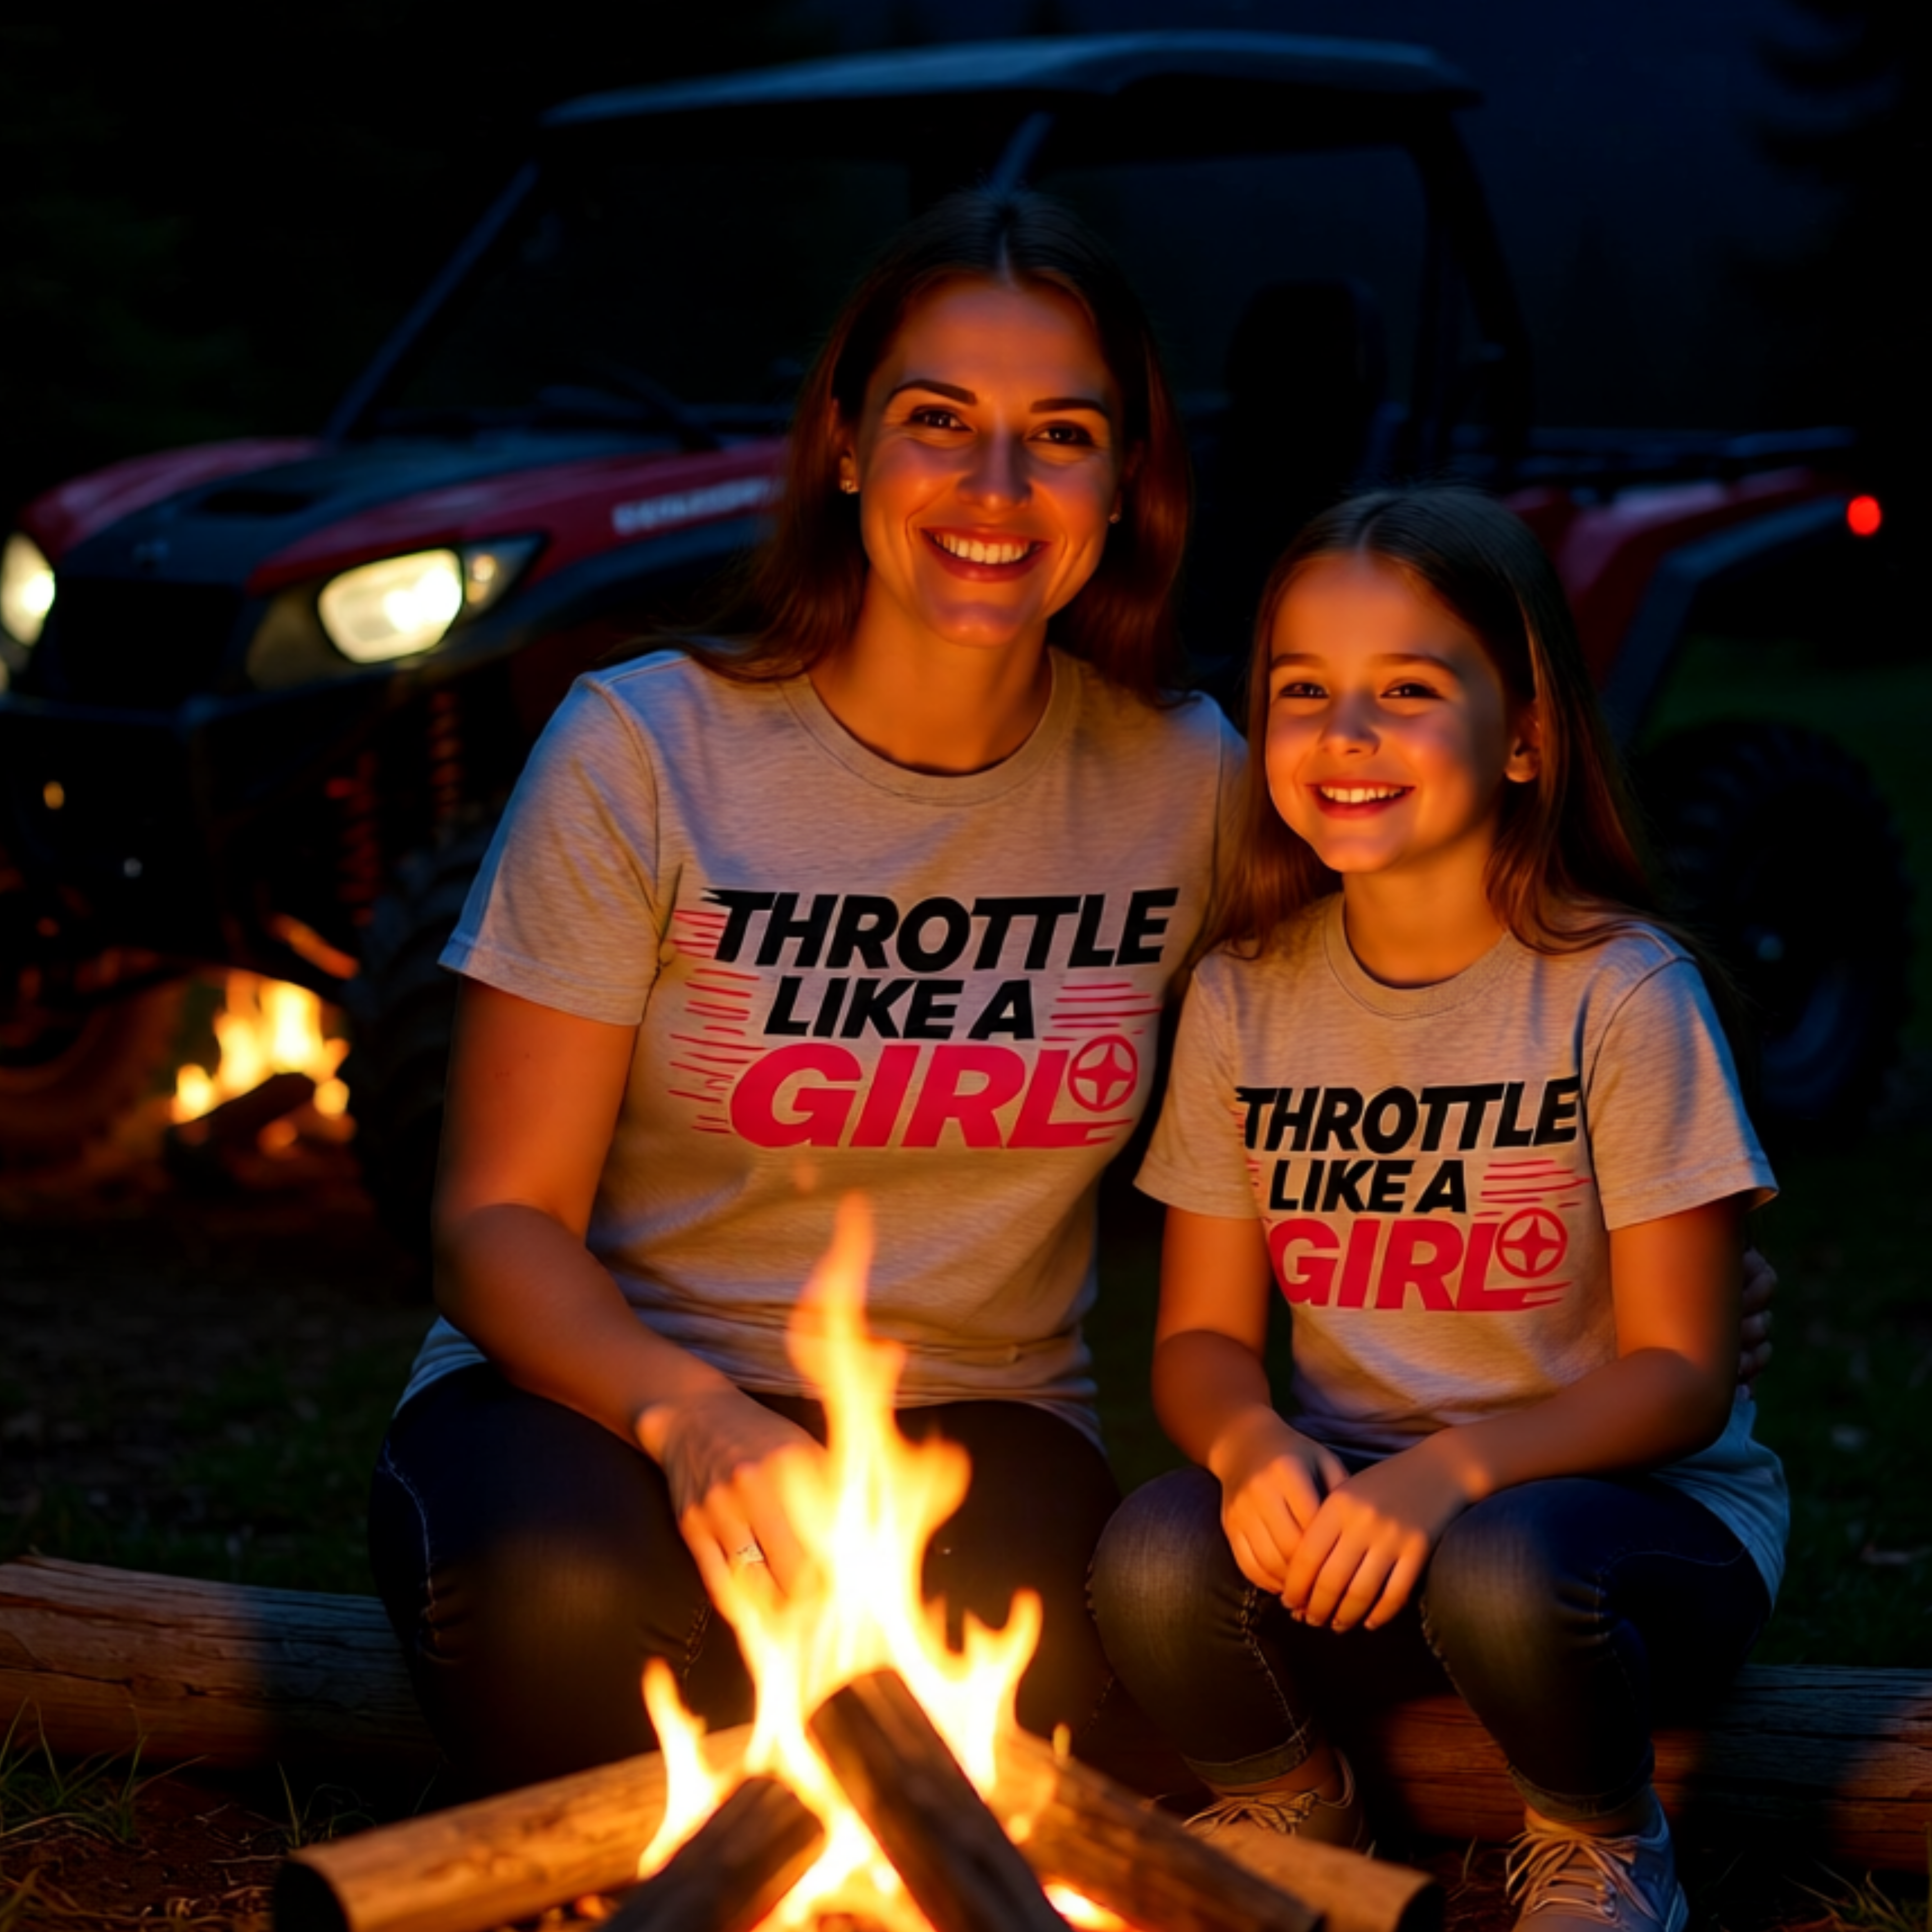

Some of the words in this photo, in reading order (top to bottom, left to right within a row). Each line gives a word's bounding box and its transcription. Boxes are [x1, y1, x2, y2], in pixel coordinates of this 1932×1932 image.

[702, 887, 1179, 973] THROTTLE
[763, 976, 965, 1040] LIKE
[968, 979, 1035, 1040] A
[730, 1042, 1132, 1149] GIRL
[1235, 1076, 1581, 1154] THROTTLE
[1269, 1159, 1415, 1213] LIKE
[1413, 1159, 1466, 1213] A
[1269, 1218, 1571, 1311] GIRL
